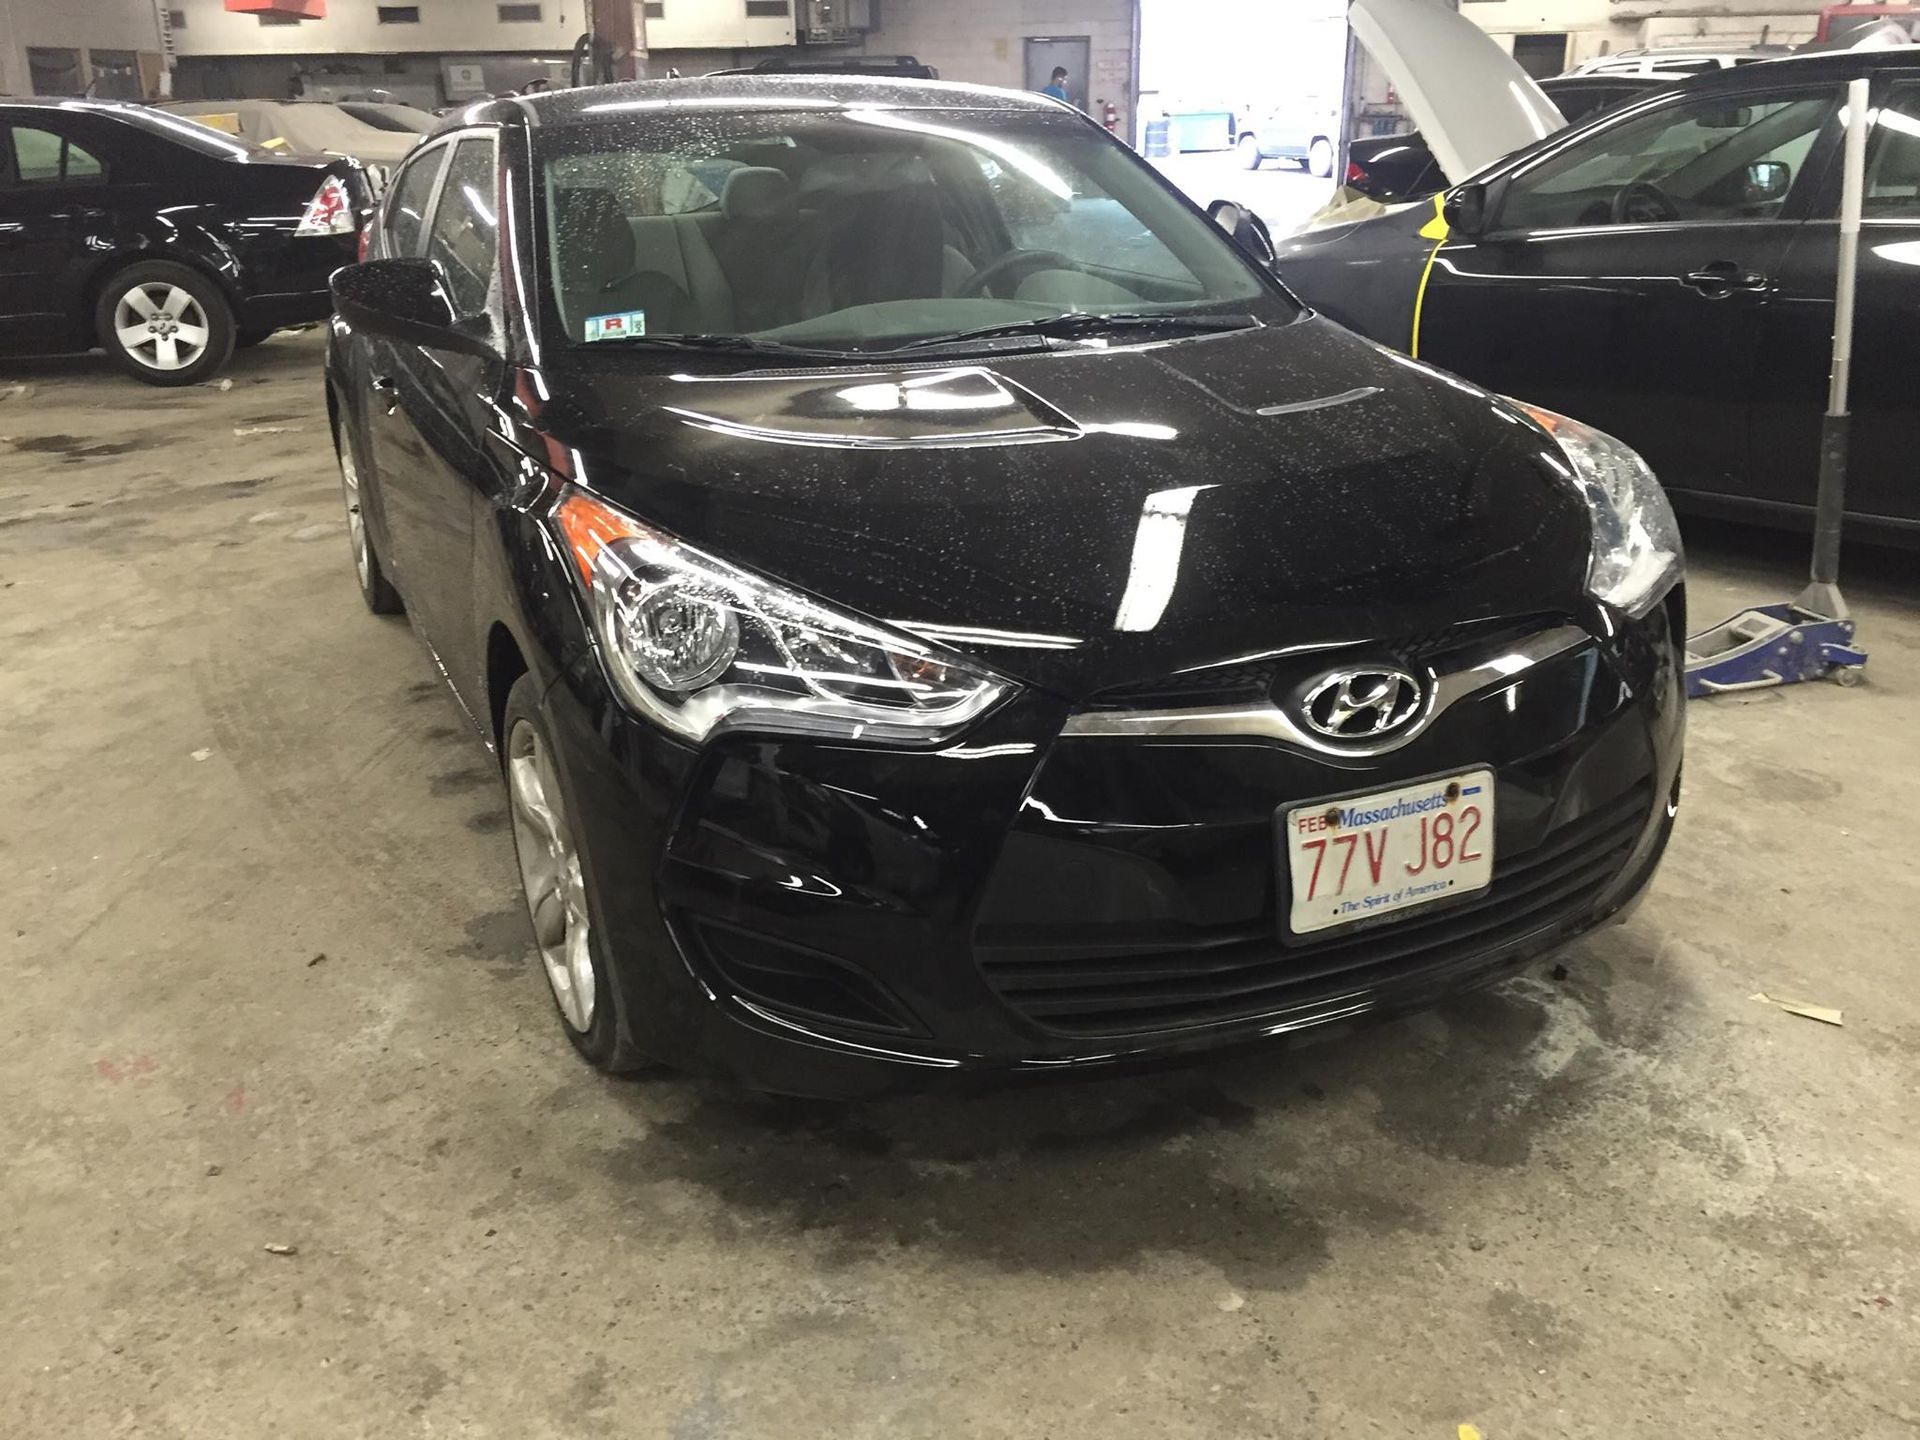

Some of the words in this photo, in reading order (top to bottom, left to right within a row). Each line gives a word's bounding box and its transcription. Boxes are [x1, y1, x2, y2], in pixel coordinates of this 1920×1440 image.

[605, 318, 622, 330] R
[1298, 816, 1328, 834] FEB
[1338, 793, 1448, 829] Massachusetts
[1302, 826, 1387, 902] 77V
[1405, 806, 1482, 876] J82
[1341, 900, 1361, 913] The
[1363, 892, 1391, 909] Spirit
[1393, 888, 1404, 902] of
[1406, 881, 1447, 896] America
